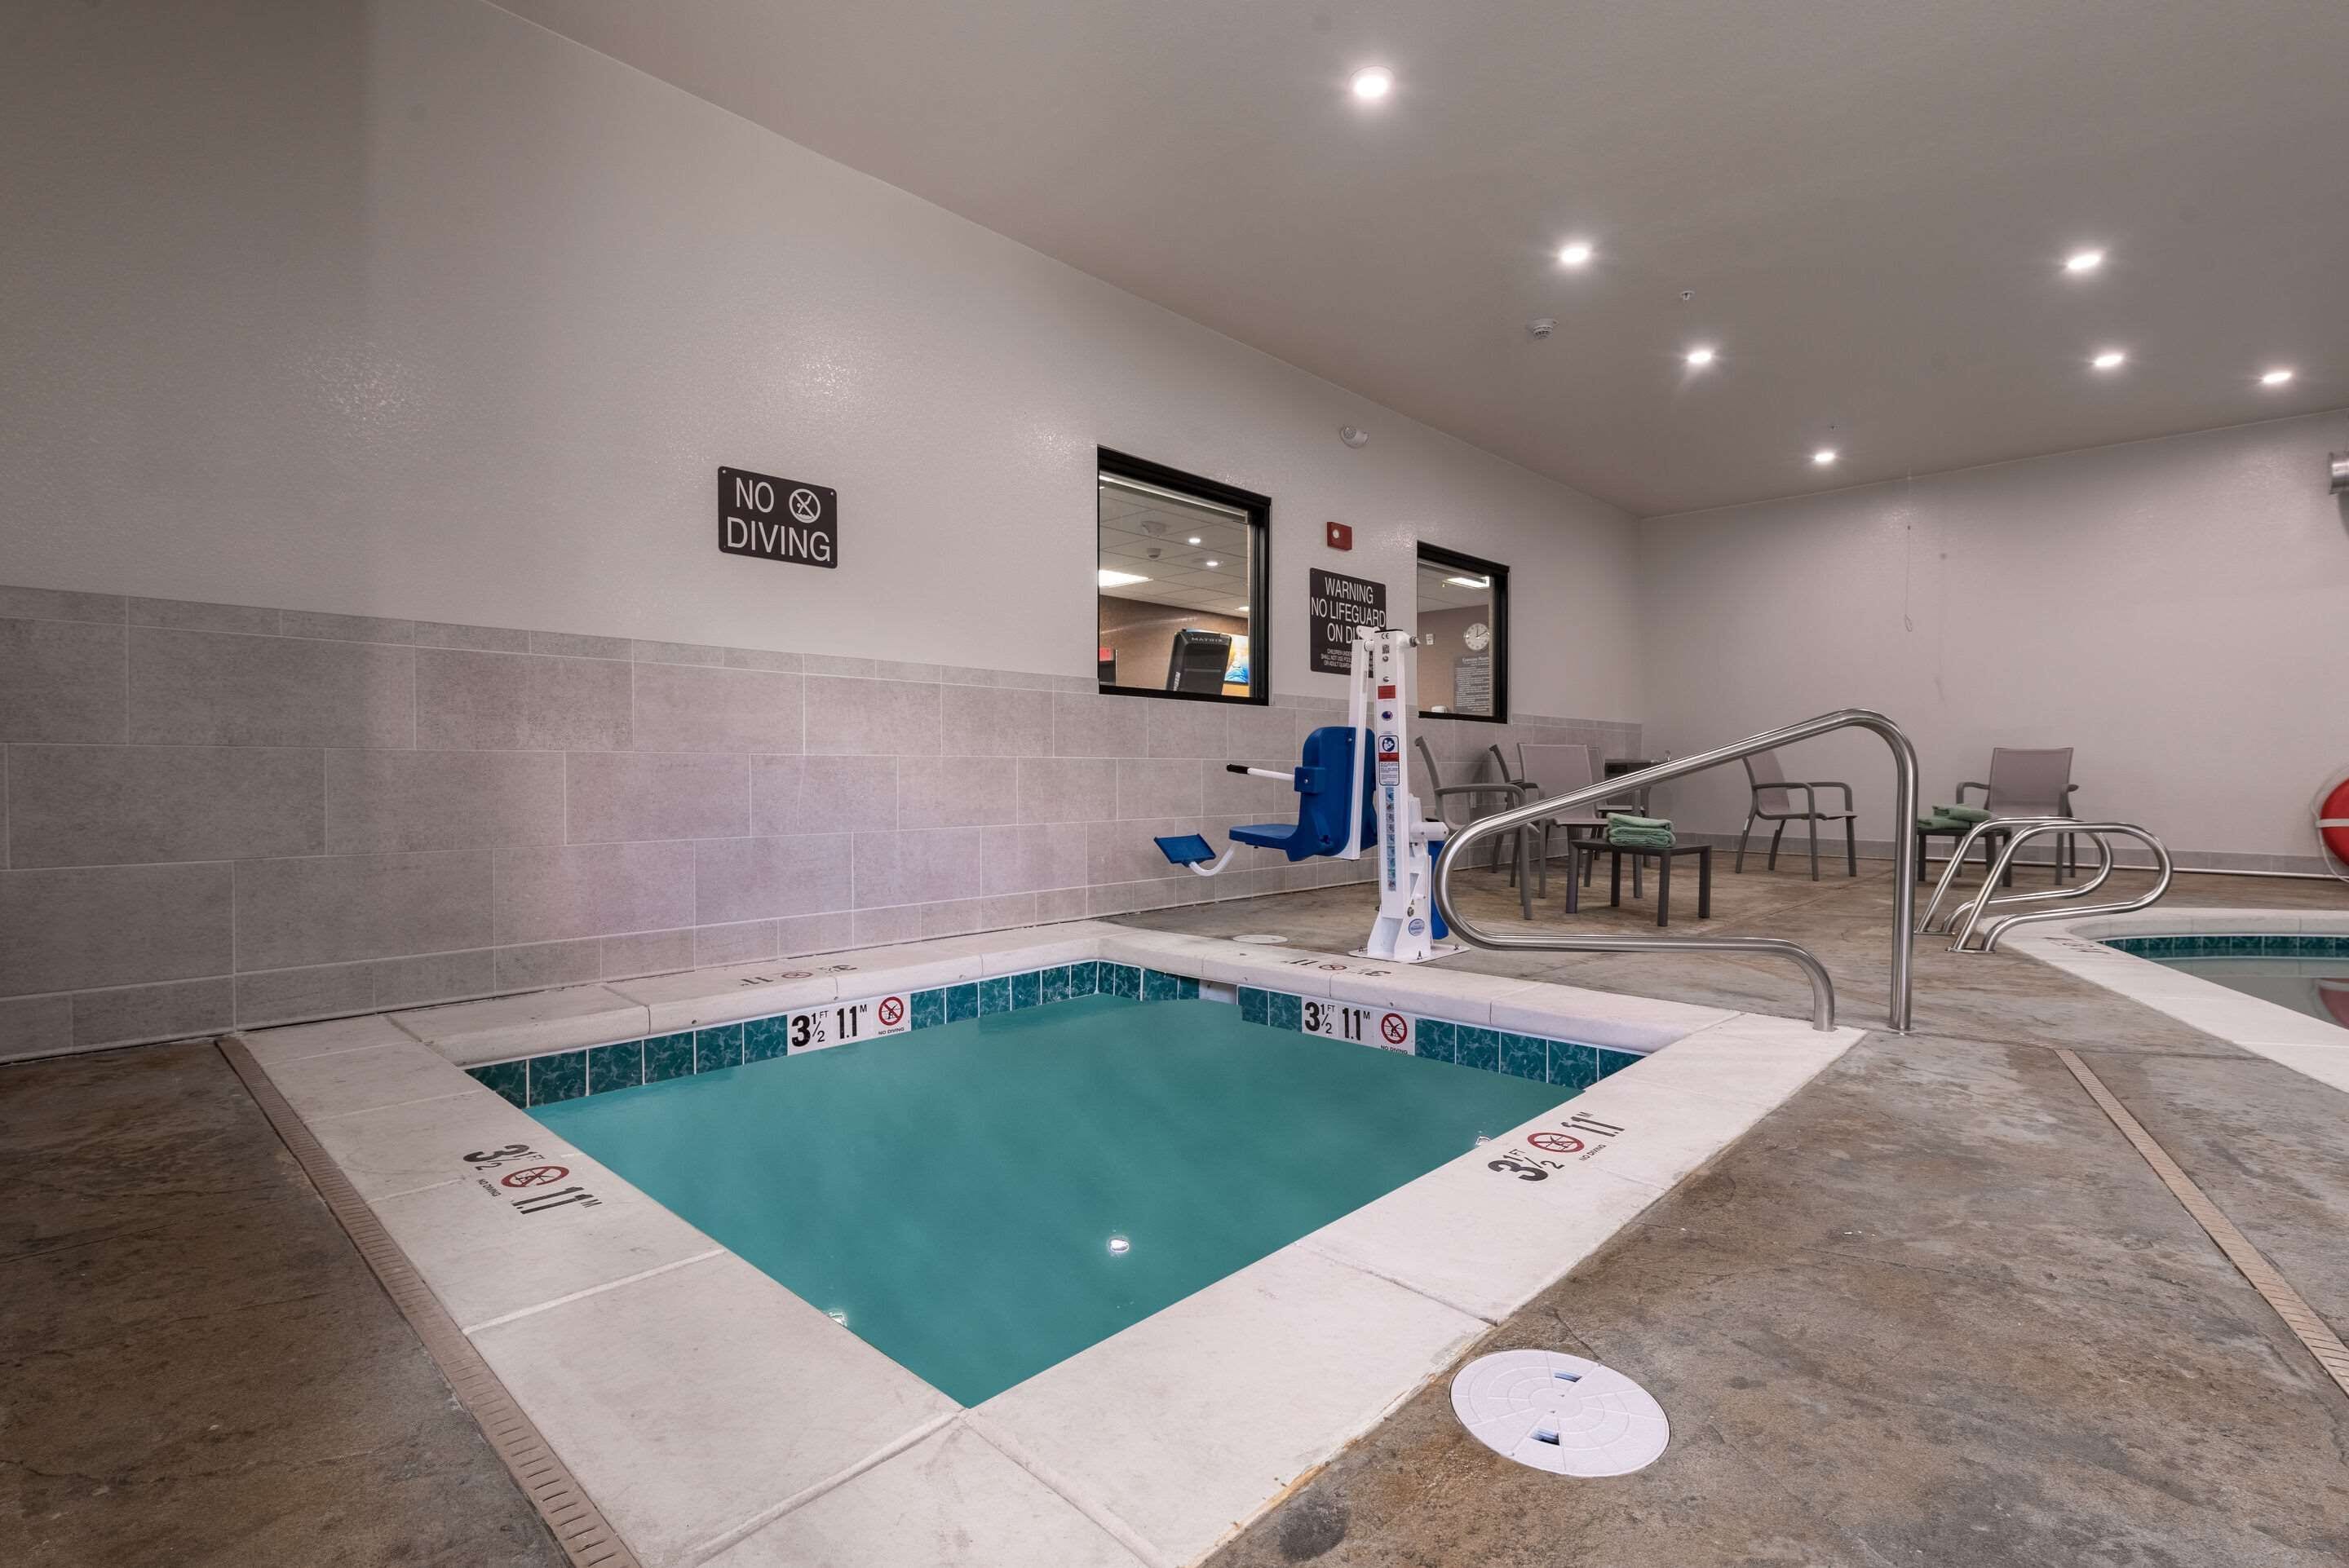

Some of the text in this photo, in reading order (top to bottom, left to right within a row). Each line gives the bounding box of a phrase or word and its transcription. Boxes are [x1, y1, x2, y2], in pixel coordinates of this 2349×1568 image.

[736, 477, 775, 513] NO
[727, 516, 830, 562] DIVING
[1325, 576, 1374, 604] WARNING
[1311, 596, 1386, 628] NO LIFEGUARD
[1327, 622, 1343, 643] ON
[860, 1004, 868, 1013] M
[1364, 1011, 1370, 1020] M
[1390, 1047, 1408, 1055] DIVING
